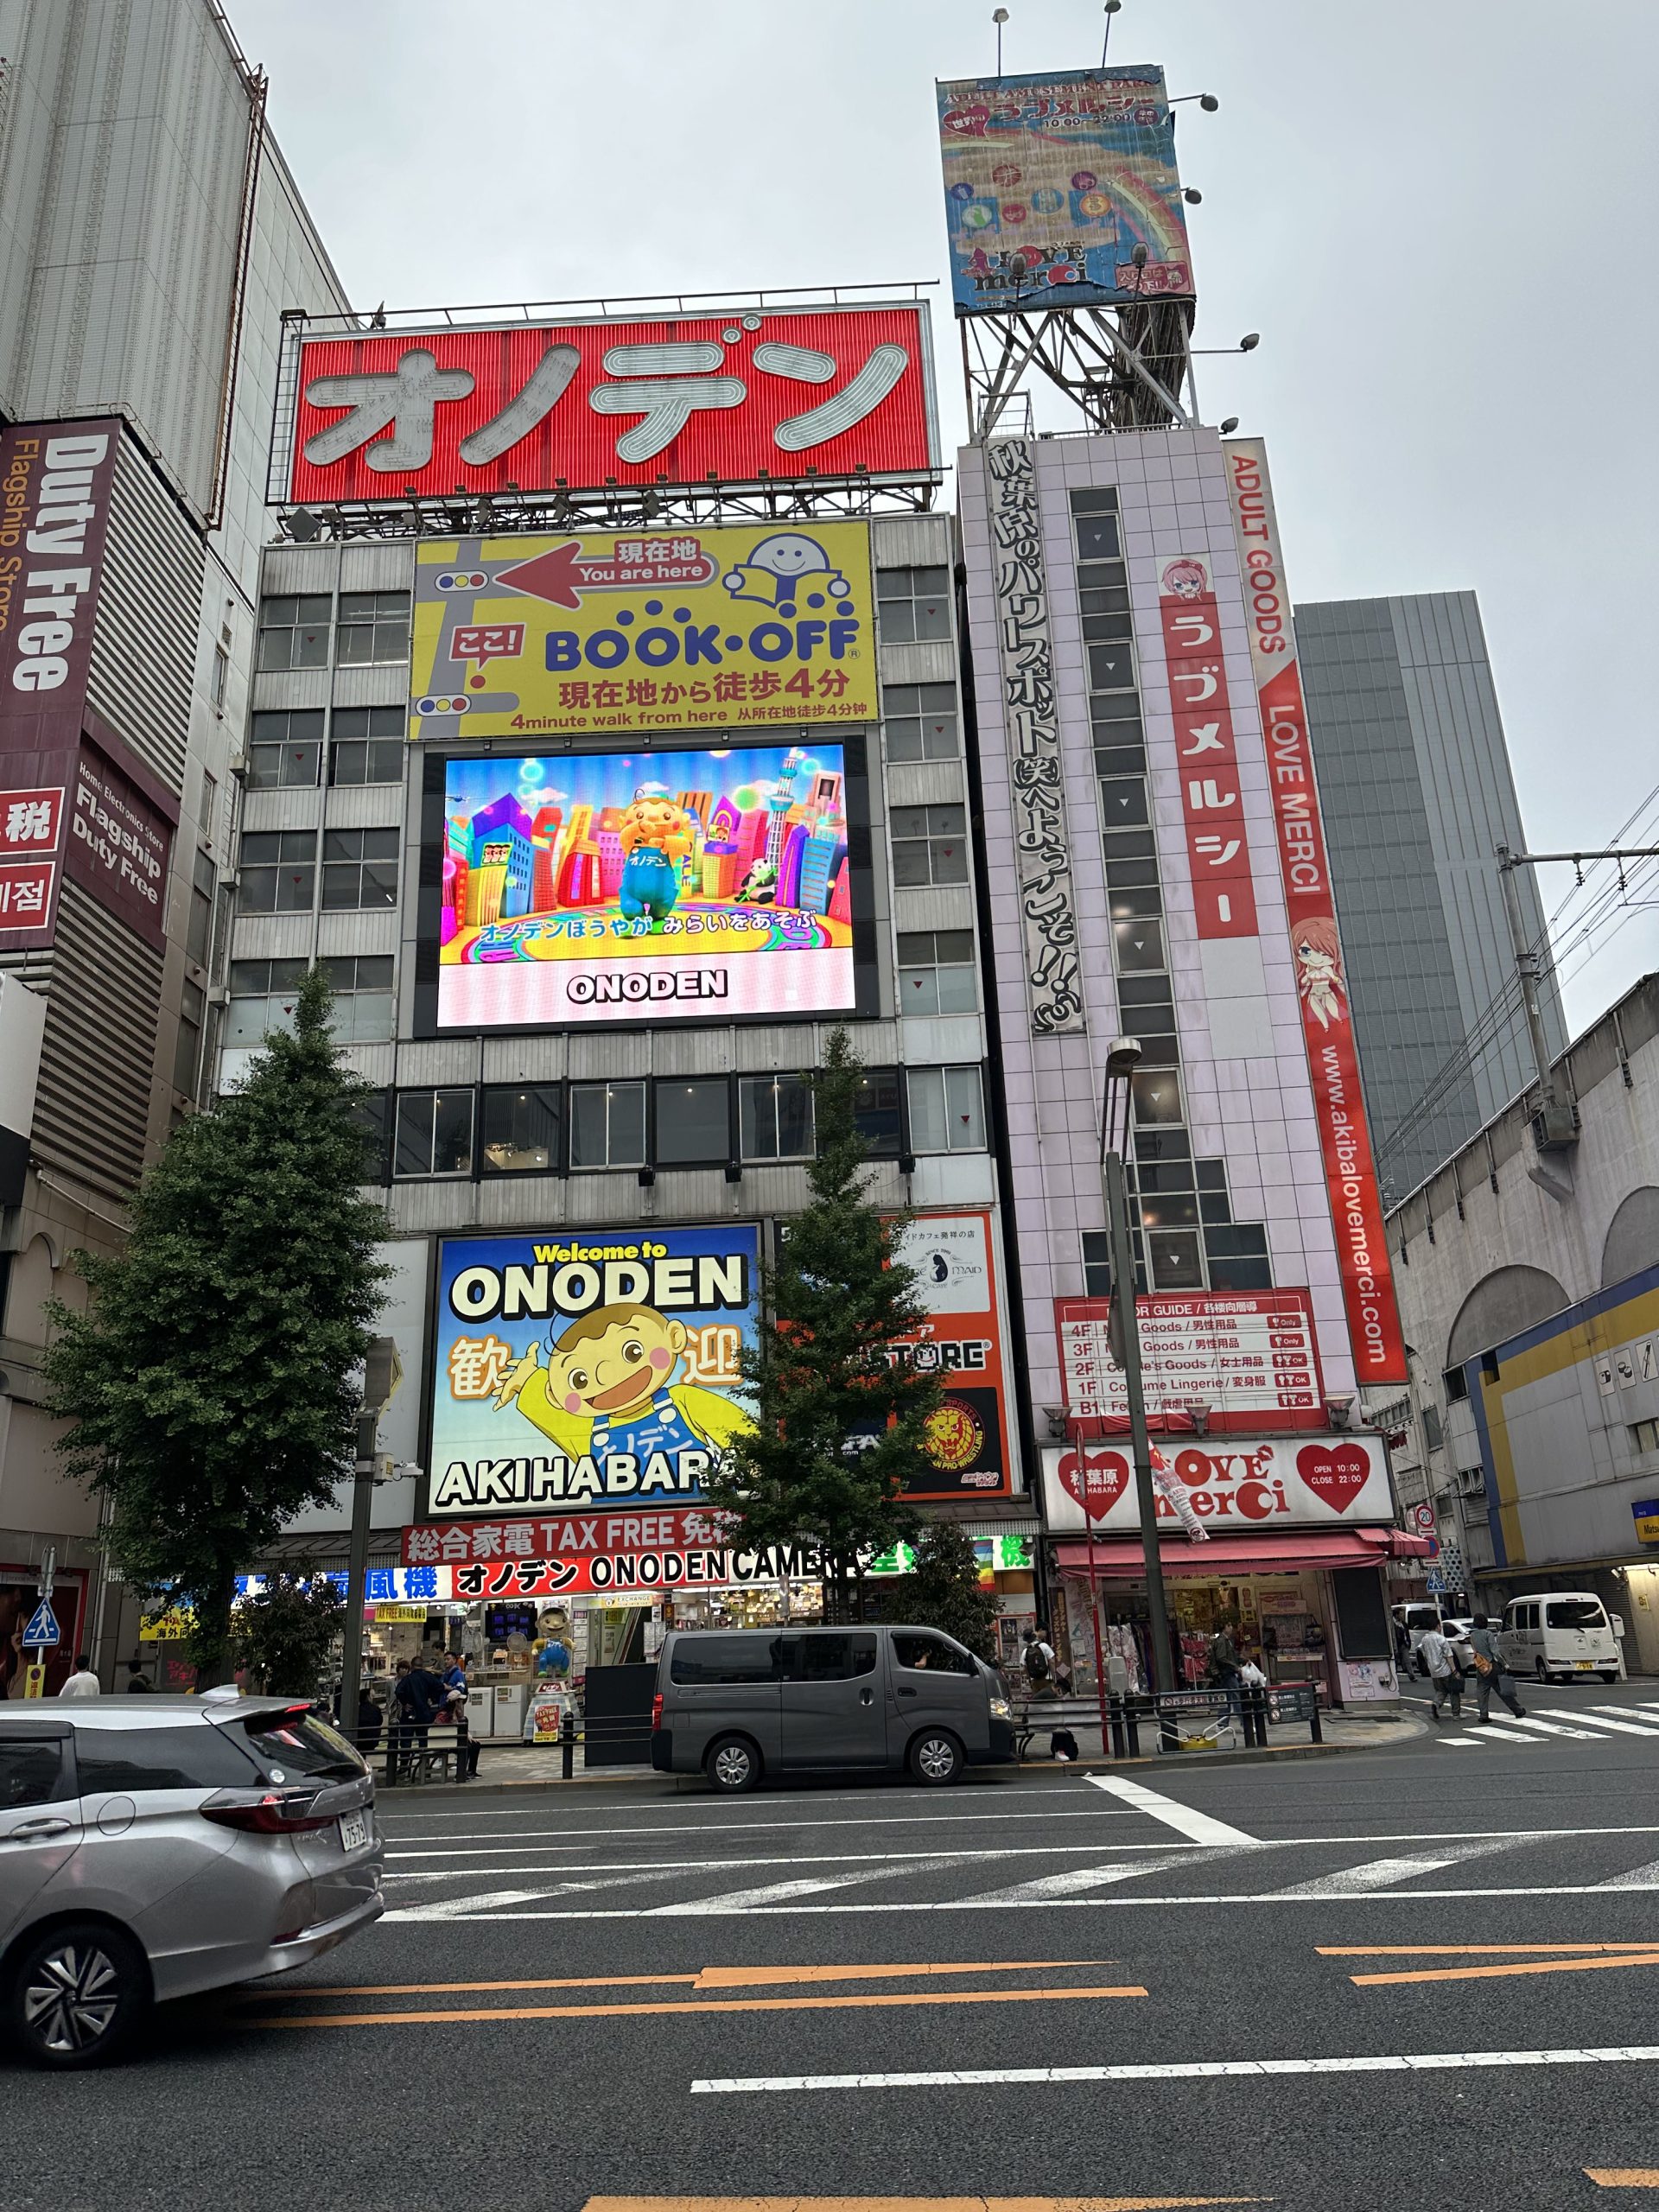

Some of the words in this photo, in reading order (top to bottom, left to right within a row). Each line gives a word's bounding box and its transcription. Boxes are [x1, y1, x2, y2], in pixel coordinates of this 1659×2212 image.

[305, 312, 909, 473] オノデン
[0, 439, 40, 547] Flagship
[26, 434, 109, 555] Duty
[1232, 454, 1270, 541] ADULT
[617, 541, 697, 563] 現在地
[579, 567, 607, 582] You
[612, 567, 642, 581] are
[647, 563, 703, 579] here
[1246, 549, 1286, 654] GOODS
[13, 567, 92, 691] Free
[459, 630, 516, 652] ここ!
[558, 668, 850, 709] 現在地から徒歩4分
[511, 712, 588, 730] 4minute
[593, 711, 632, 726] walk
[638, 709, 683, 724] from
[688, 708, 728, 722] here
[1268, 705, 1305, 784] LOVE
[1169, 614, 1243, 925] ラブメルシー
[79, 761, 103, 792] Home
[104, 785, 144, 832] Electronics
[144, 826, 164, 853] Store
[76, 782, 162, 879] Flagship
[1281, 791, 1322, 893] MERCI
[73, 812, 118, 870] Duty
[120, 856, 158, 905] Free
[628, 855, 667, 868] オノデン
[479, 916, 653, 943] オノデンぼうやが
[663, 910, 817, 934] みらいをあそぶ
[567, 969, 728, 1005] ONODEN
[1322, 1045, 1386, 1363] www.akibalovemerci.com
[533, 1243, 639, 1262] Welcome
[643, 1242, 666, 1258] to
[905, 1230, 975, 1241] イドカフェ発祥の店
[448, 1254, 747, 1324] ONODEN
[1071, 1325, 1090, 1336] 4F
[1141, 1321, 1182, 1334] Goods
[1192, 1319, 1237, 1331] 男性用品
[1153, 1304, 1192, 1315] GUIDE
[1073, 1343, 1093, 1356] 3F
[1143, 1339, 1185, 1353] Goods
[1195, 1338, 1239, 1351] 男性用品
[1283, 1338, 1300, 1346] Only
[1075, 1361, 1095, 1376] 2F
[1166, 1358, 1207, 1370] Goods
[1220, 1356, 1264, 1369] 女士用品
[1078, 1381, 1096, 1395] 1F
[1109, 1382, 1167, 1392] Coume
[1171, 1377, 1224, 1391] Lingerie
[1080, 1401, 1099, 1414] B1
[1175, 1449, 1269, 1486] OVE
[1337, 1464, 1360, 1472] 10:00
[1338, 1475, 1362, 1484] 22:00
[1420, 1512, 1431, 1522] 20
[407, 1522, 535, 1562] 総合家電
[541, 1520, 599, 1552] TAX
[607, 1516, 676, 1548] FREE
[457, 1560, 577, 1594] オノデン
[591, 1550, 727, 1588] ONODEN
